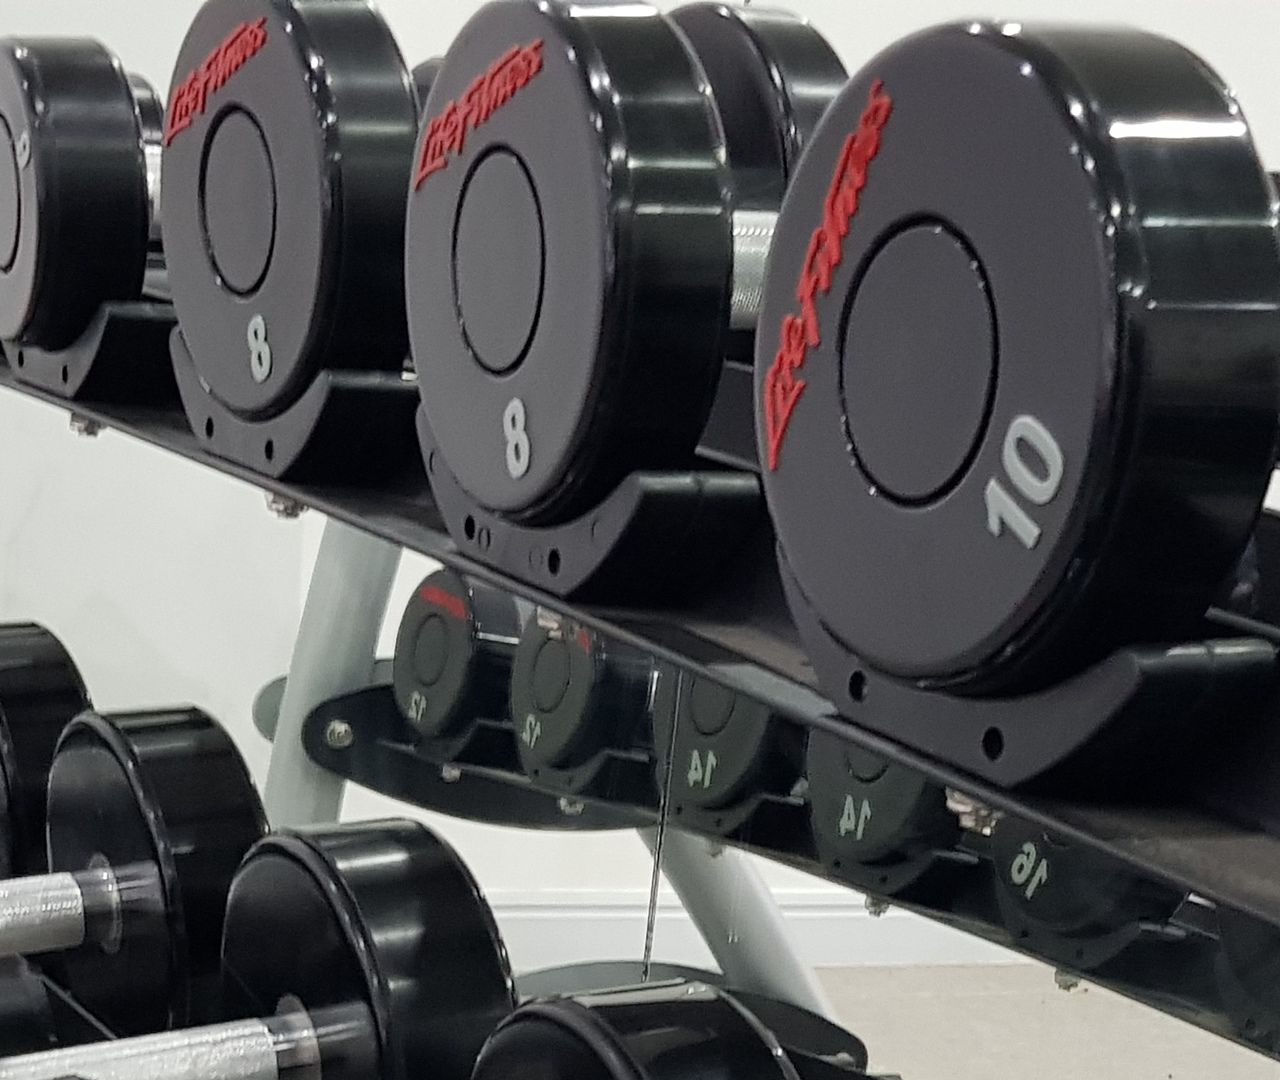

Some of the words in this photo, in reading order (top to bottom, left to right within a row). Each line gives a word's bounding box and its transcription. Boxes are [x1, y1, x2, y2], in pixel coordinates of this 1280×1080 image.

[247, 314, 273, 384] 8
[502, 397, 531, 479] 8
[984, 414, 1064, 550] 10
